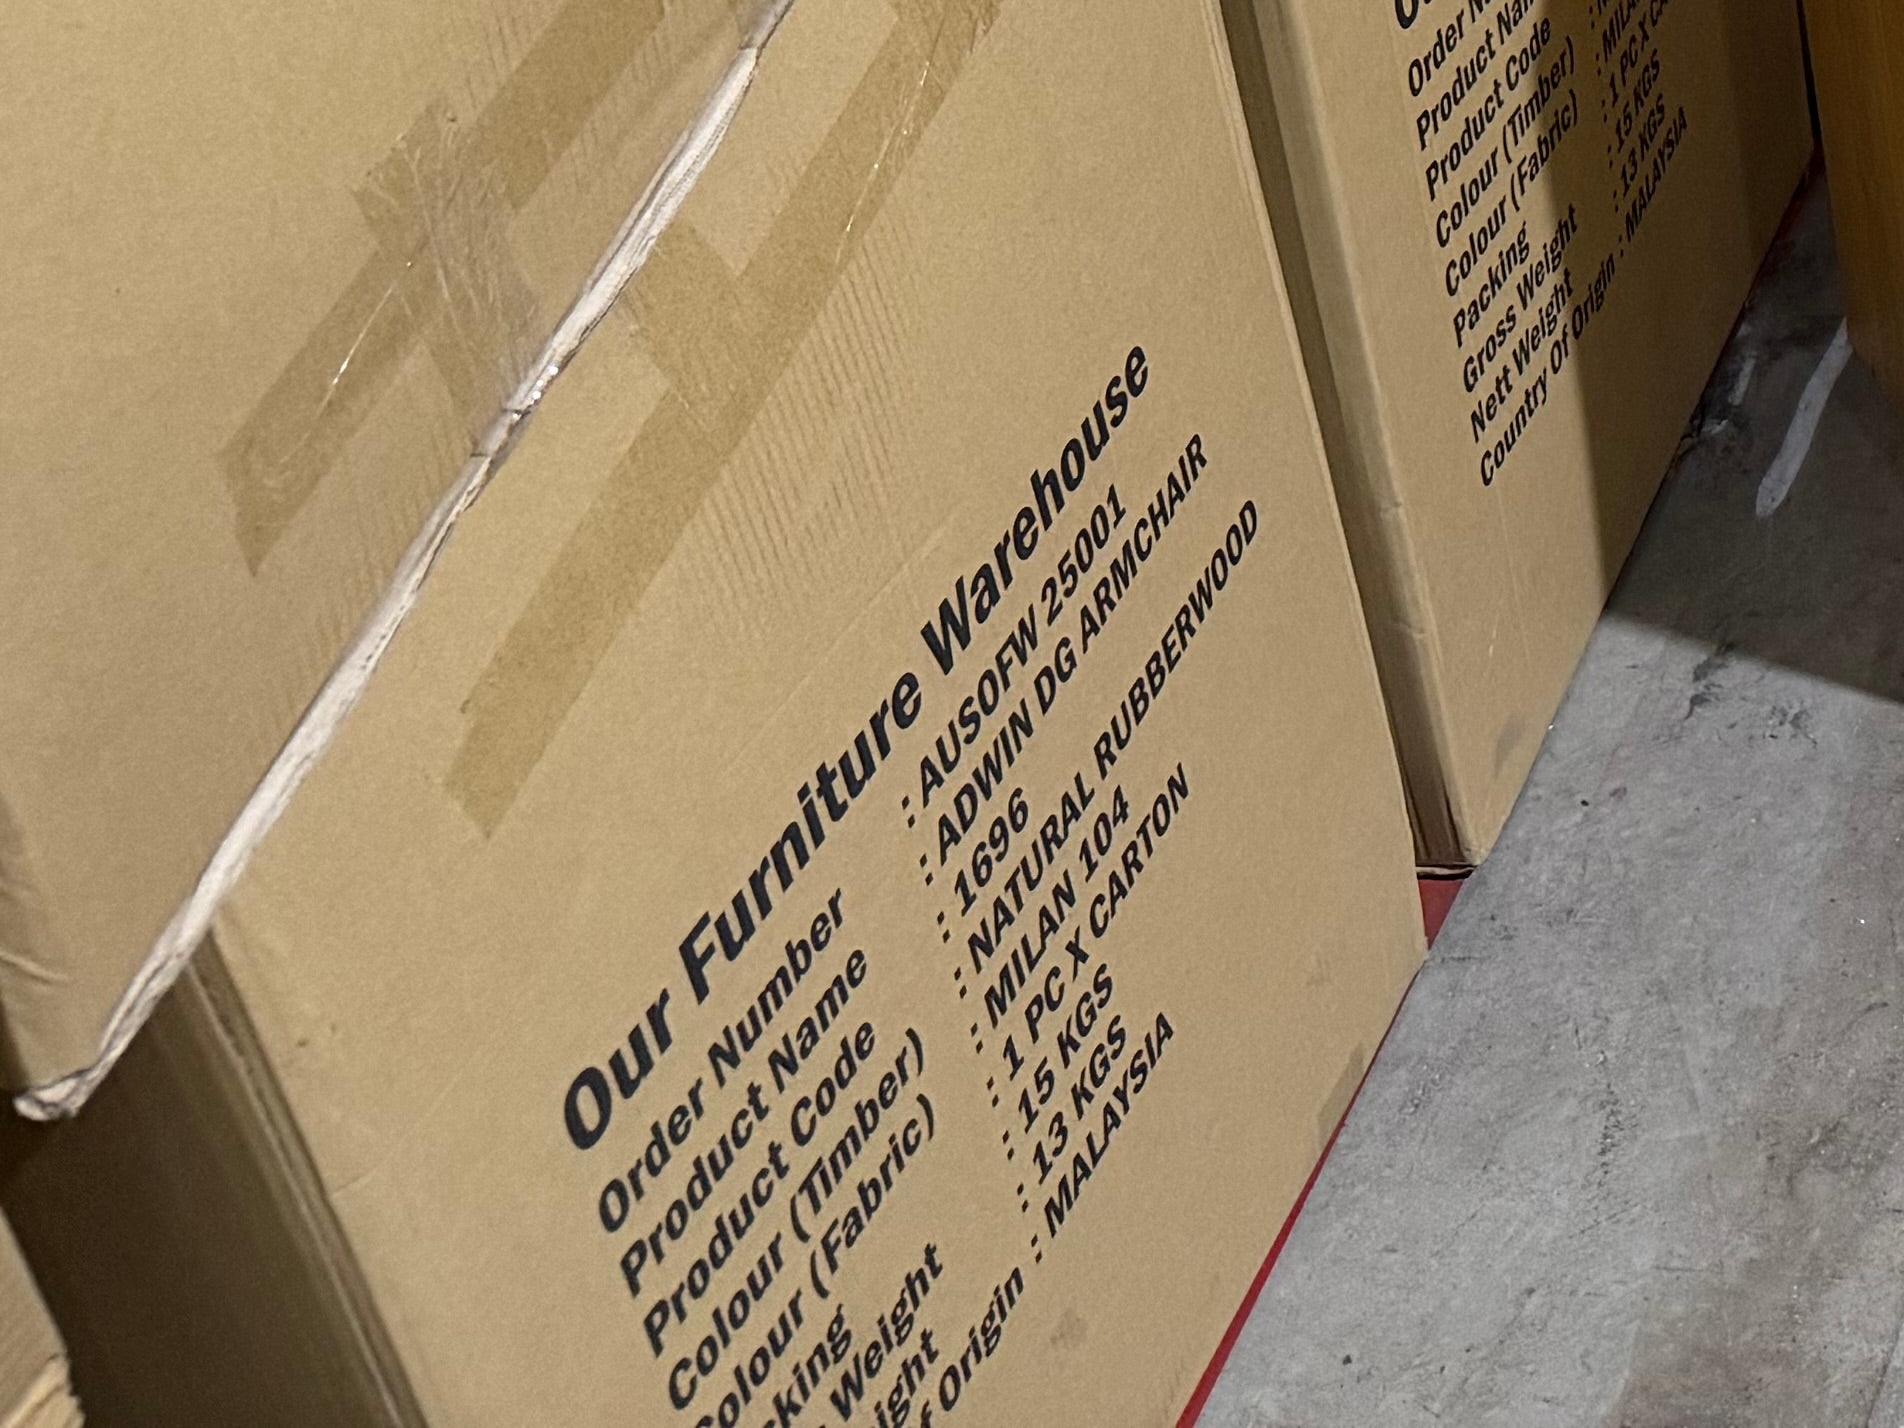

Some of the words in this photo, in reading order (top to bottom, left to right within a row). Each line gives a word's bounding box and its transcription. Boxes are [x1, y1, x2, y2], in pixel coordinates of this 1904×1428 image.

[1407, 8, 1464, 96] Order
[1444, 194, 1506, 296] Colour
[1510, 87, 1575, 212] (Fabric)
[1452, 219, 1530, 348] Packing
[1608, 72, 1618, 107] 1
[1619, 33, 1638, 87] PC
[1638, 11, 1649, 51] X
[565, 986, 671, 1149] Our
[678, 672, 921, 1005] Furniture
[920, 347, 1147, 674] Warehouse
[599, 1077, 703, 1232] Order
[707, 887, 843, 1088] Number
[920, 603, 1038, 808] AUSOFW
[1041, 483, 1125, 627] 25001
[621, 1081, 769, 1298] Product
[768, 949, 867, 1094] Name
[938, 697, 1033, 866] ADWIN
[1034, 636, 1077, 715] DG
[1081, 434, 1206, 654] ARMCHAIR
[644, 1140, 789, 1357] Product
[790, 1021, 875, 1146] Code
[954, 787, 1028, 917] 1696
[669, 1231, 782, 1409] Colour
[789, 1027, 923, 1242] (Timber)
[968, 771, 1095, 974] NATURAL
[1094, 502, 1257, 781] RUBBERWOOD
